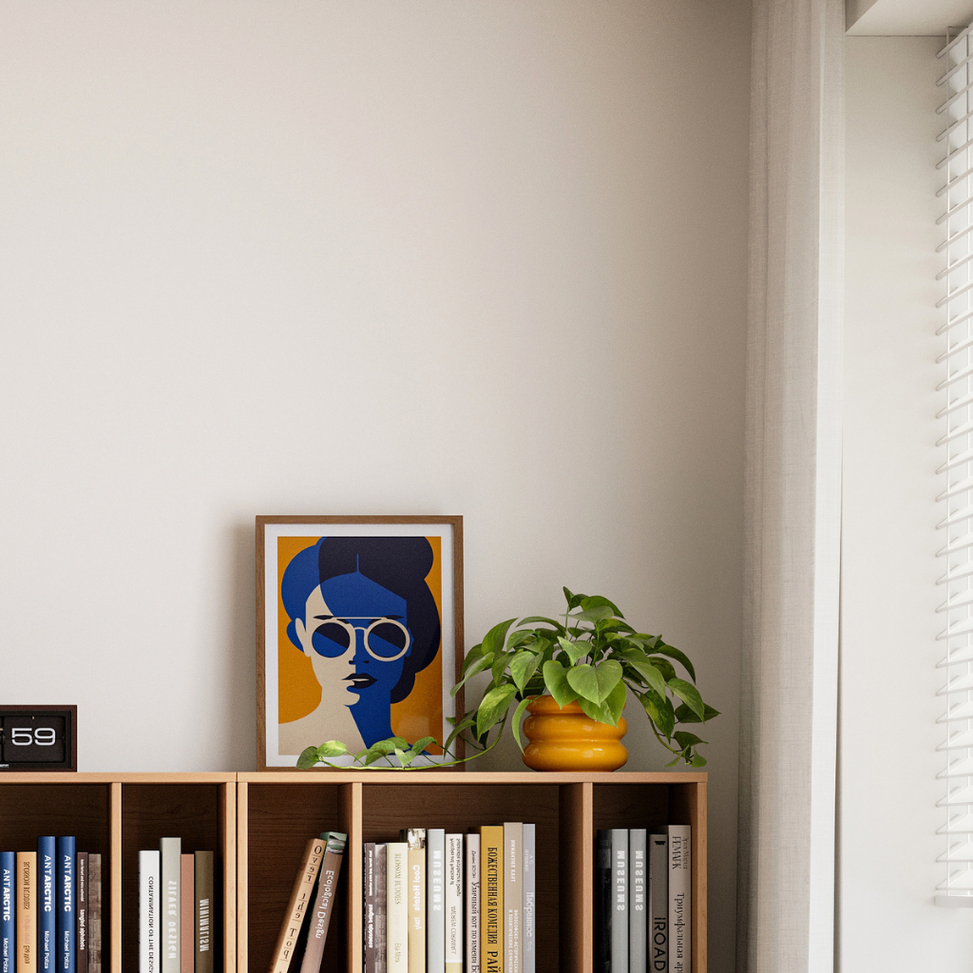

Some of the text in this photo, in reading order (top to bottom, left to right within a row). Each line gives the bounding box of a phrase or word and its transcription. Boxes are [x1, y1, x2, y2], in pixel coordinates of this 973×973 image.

[11, 727, 56, 746] 59
[471, 881, 480, 914] Уличный
[487, 847, 501, 973] БОЖЕСТВЕННАЯ КОМЕДИЯ РАЙ
[471, 930, 477, 939] по
[674, 893, 685, 959] Триумфальная
